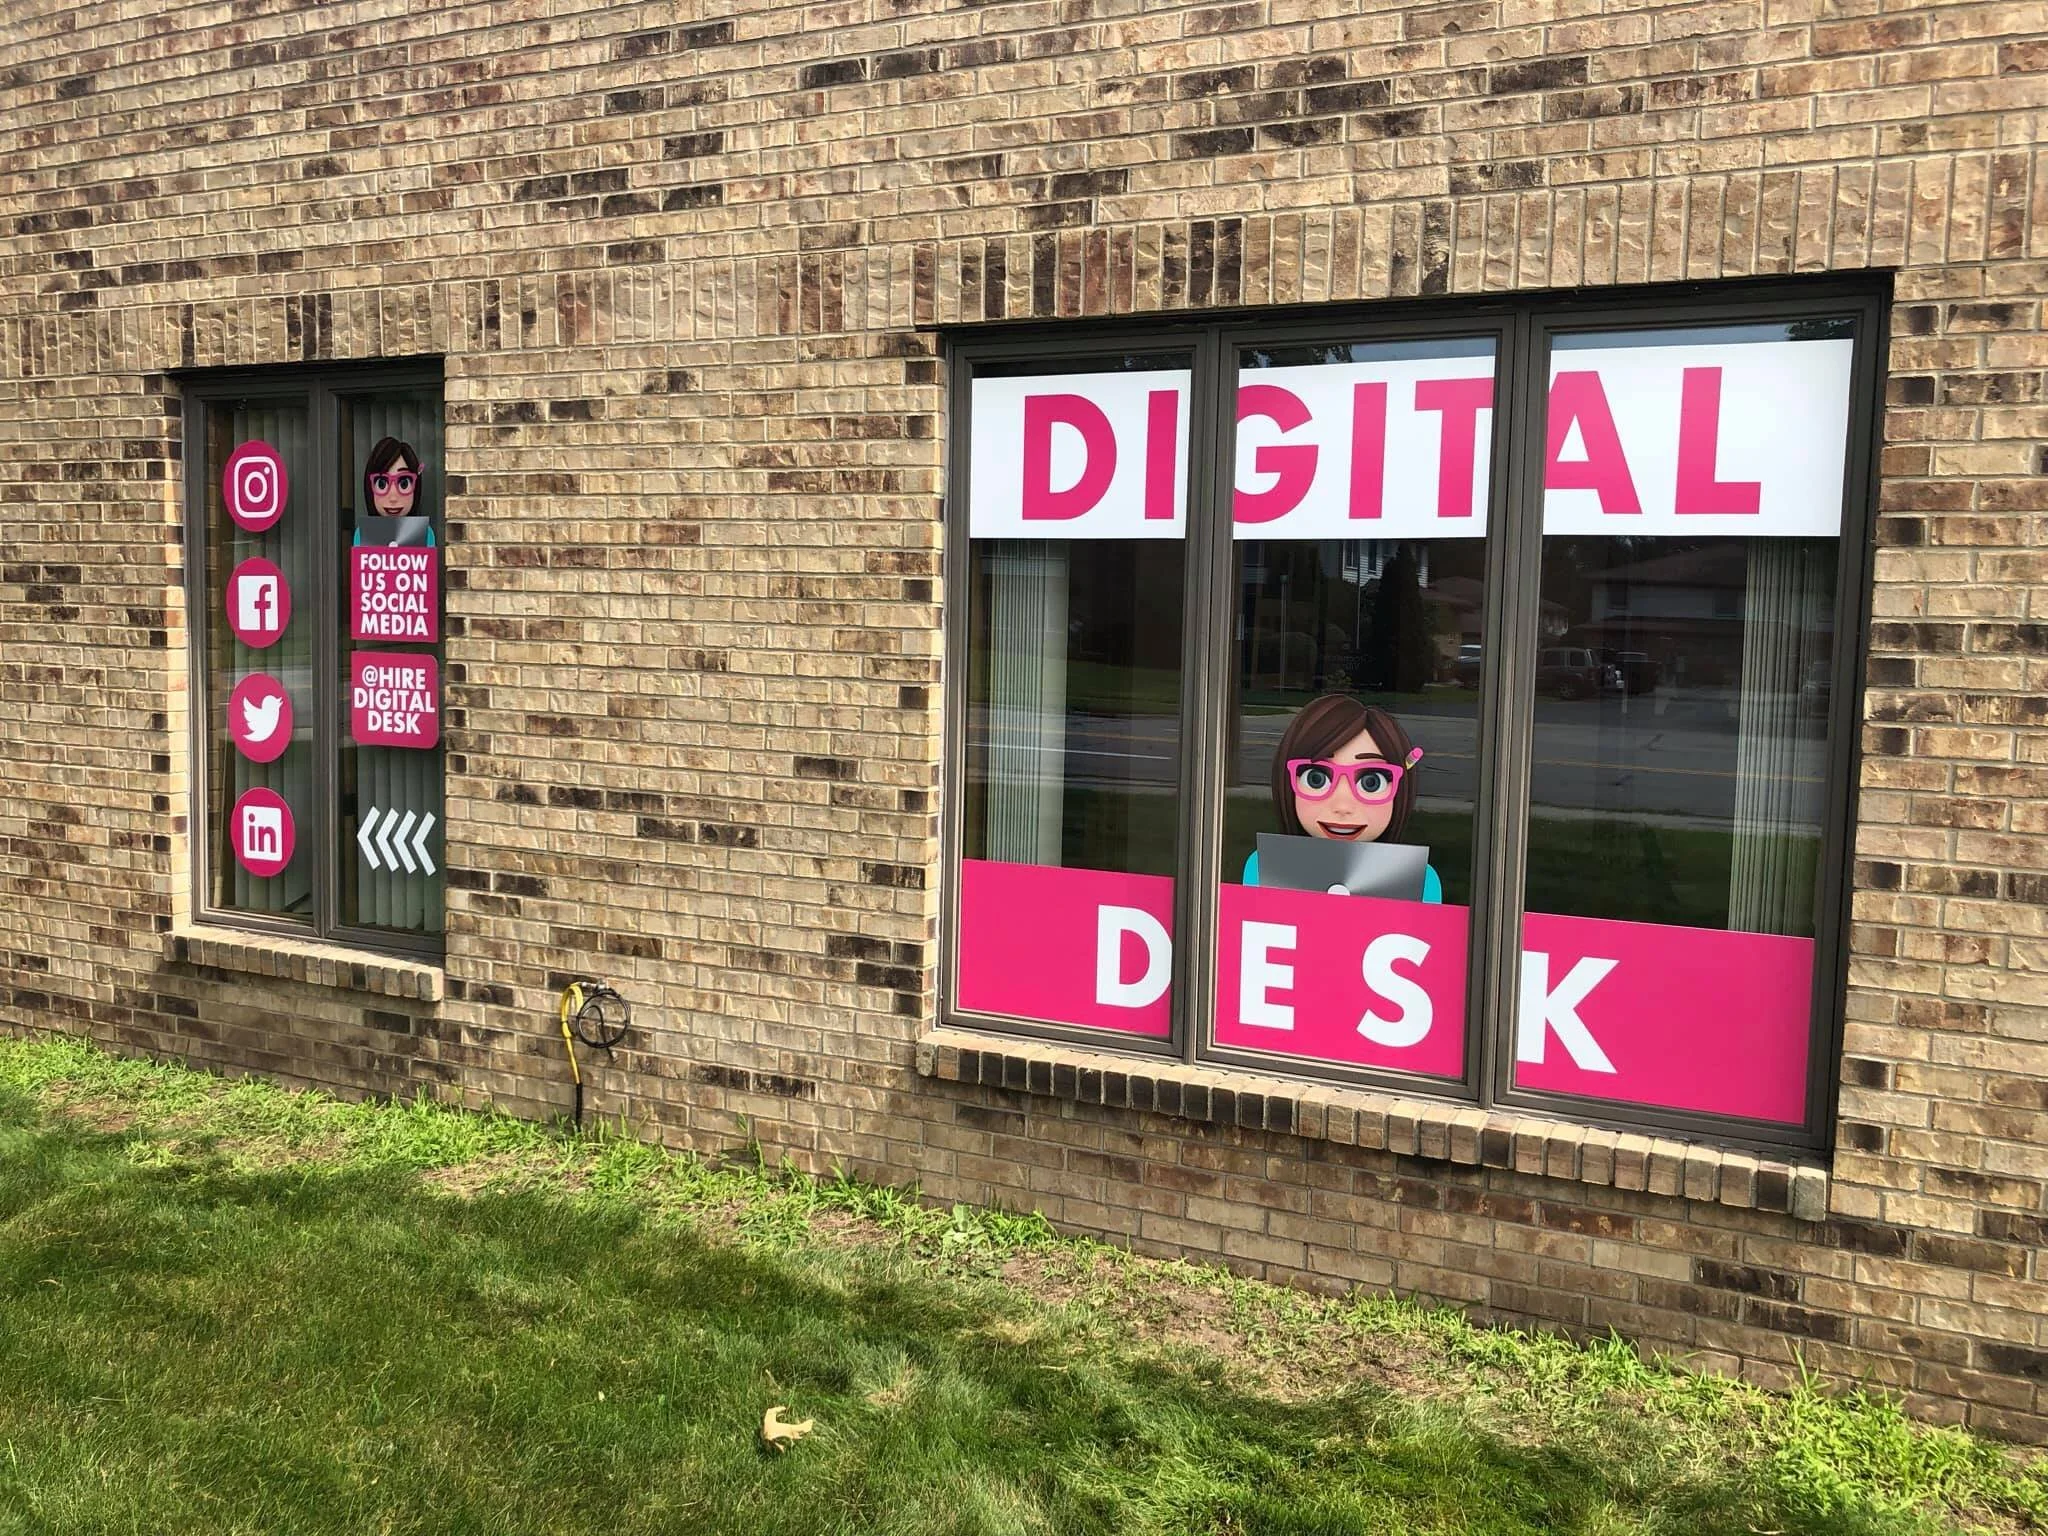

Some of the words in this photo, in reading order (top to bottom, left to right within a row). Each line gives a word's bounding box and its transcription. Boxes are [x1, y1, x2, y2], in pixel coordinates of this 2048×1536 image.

[1022, 366, 1762, 524] DIGITAL
[360, 553, 429, 572] FOLLOW
[360, 572, 386, 592] US
[395, 573, 428, 592] ON
[360, 593, 429, 613] SOCIAL
[360, 613, 429, 636] MEDIA
[361, 665, 426, 690] @HIRE
[353, 687, 436, 713] DIGITAL
[367, 711, 421, 734] DESK
[248, 812, 277, 854] in
[1096, 904, 1620, 1074] DESK
